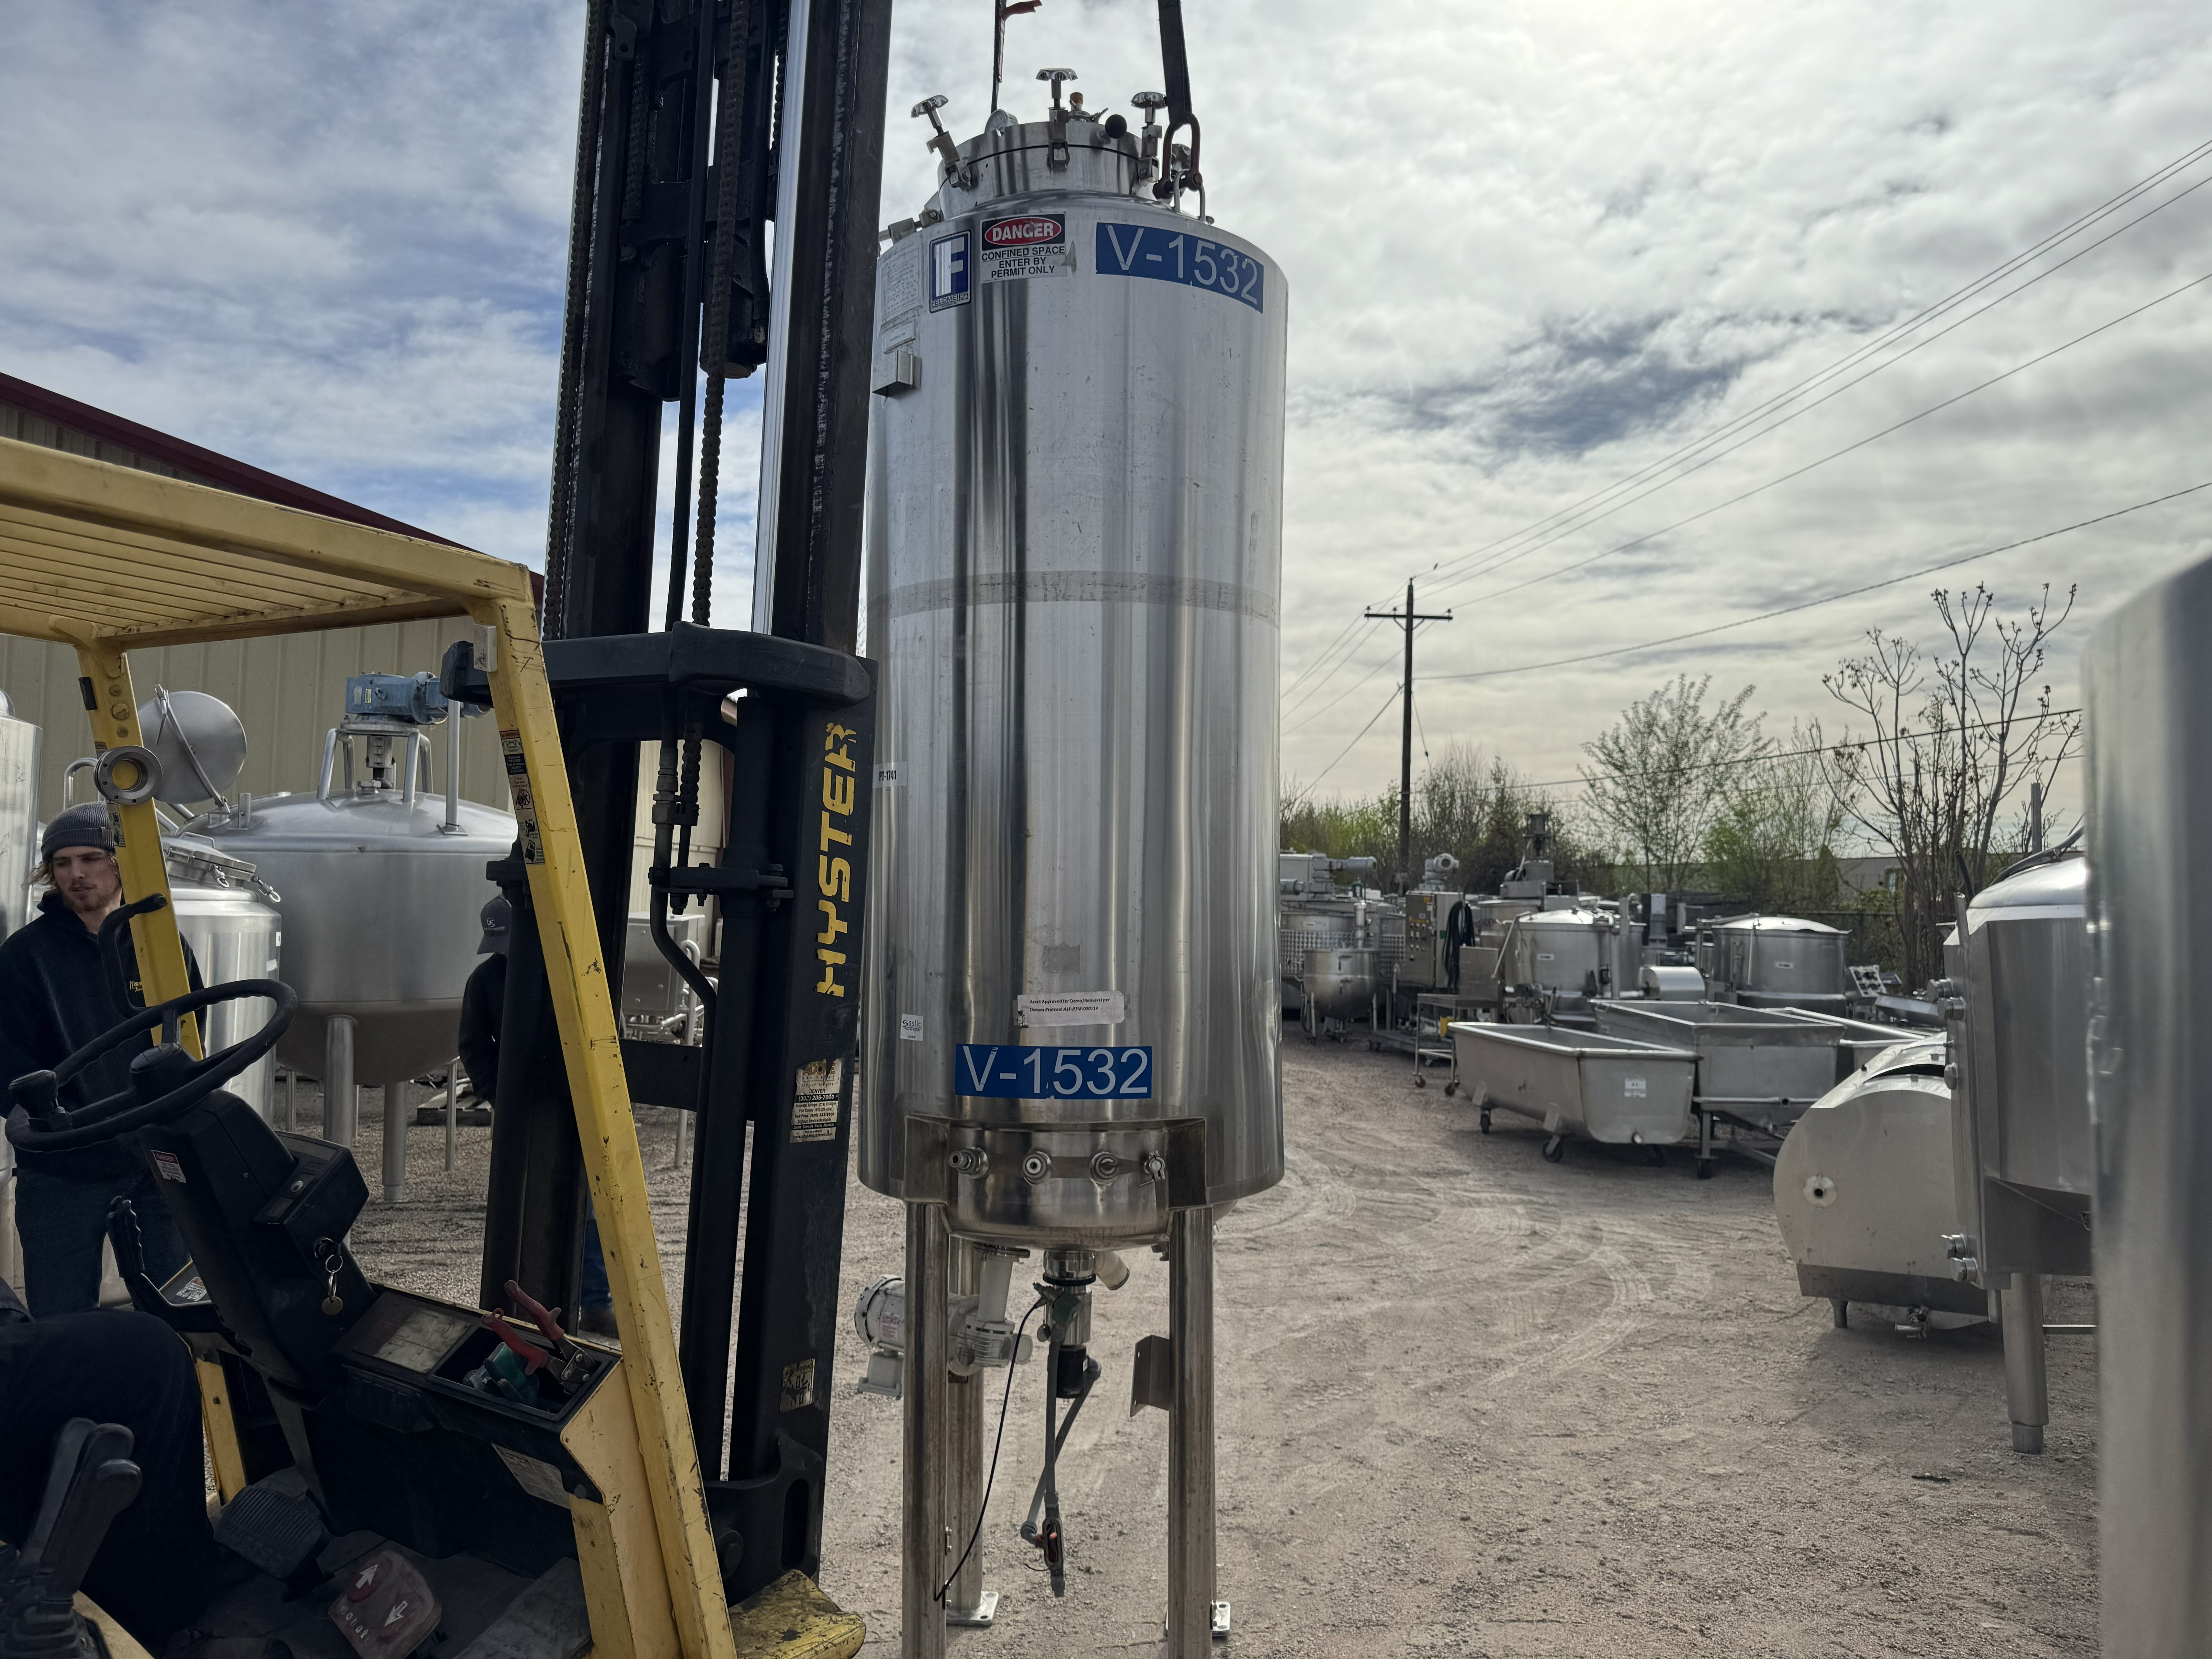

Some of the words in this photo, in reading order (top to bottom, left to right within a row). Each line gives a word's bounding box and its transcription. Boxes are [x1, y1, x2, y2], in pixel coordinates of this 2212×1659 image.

[992, 223, 1053, 242] DANGER
[982, 248, 1029, 261] CONFINED
[1032, 246, 1065, 255] SPACE
[999, 258, 1030, 268] ENTER
[1033, 257, 1046, 265] BY
[1106, 224, 1257, 305] V-1532
[991, 267, 1026, 278] PERMIT
[1029, 266, 1054, 274] ONLY
[931, 292, 968, 306] FELDMEIER
[879, 770, 896, 781] PT-1741
[815, 723, 857, 997] HYSTER
[963, 1046, 1148, 1095] V-1532
